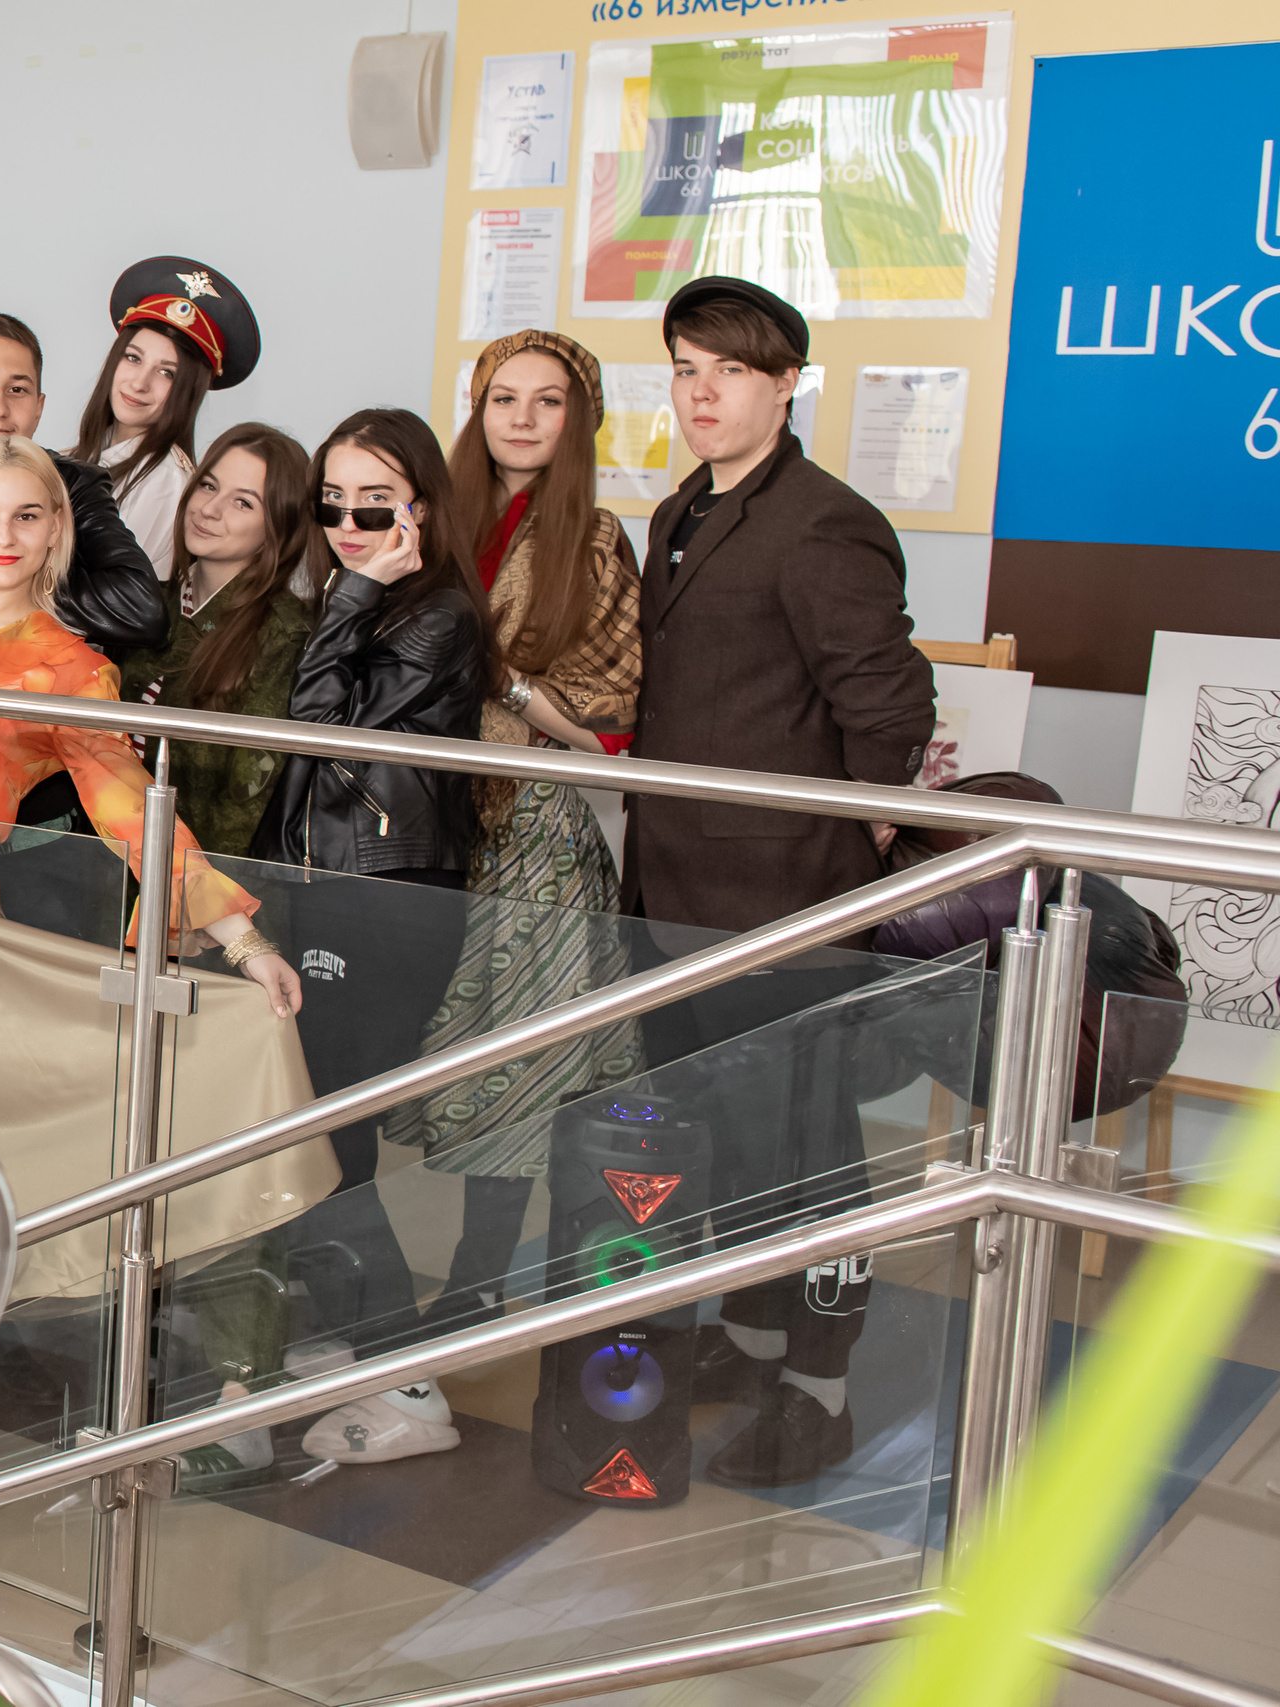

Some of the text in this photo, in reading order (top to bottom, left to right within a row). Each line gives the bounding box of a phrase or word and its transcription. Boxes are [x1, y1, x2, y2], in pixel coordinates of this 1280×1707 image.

[655, 163, 724, 182] ШКОЛ
[680, 180, 702, 198] 66
[301, 949, 346, 979] EXCLUSIVE
